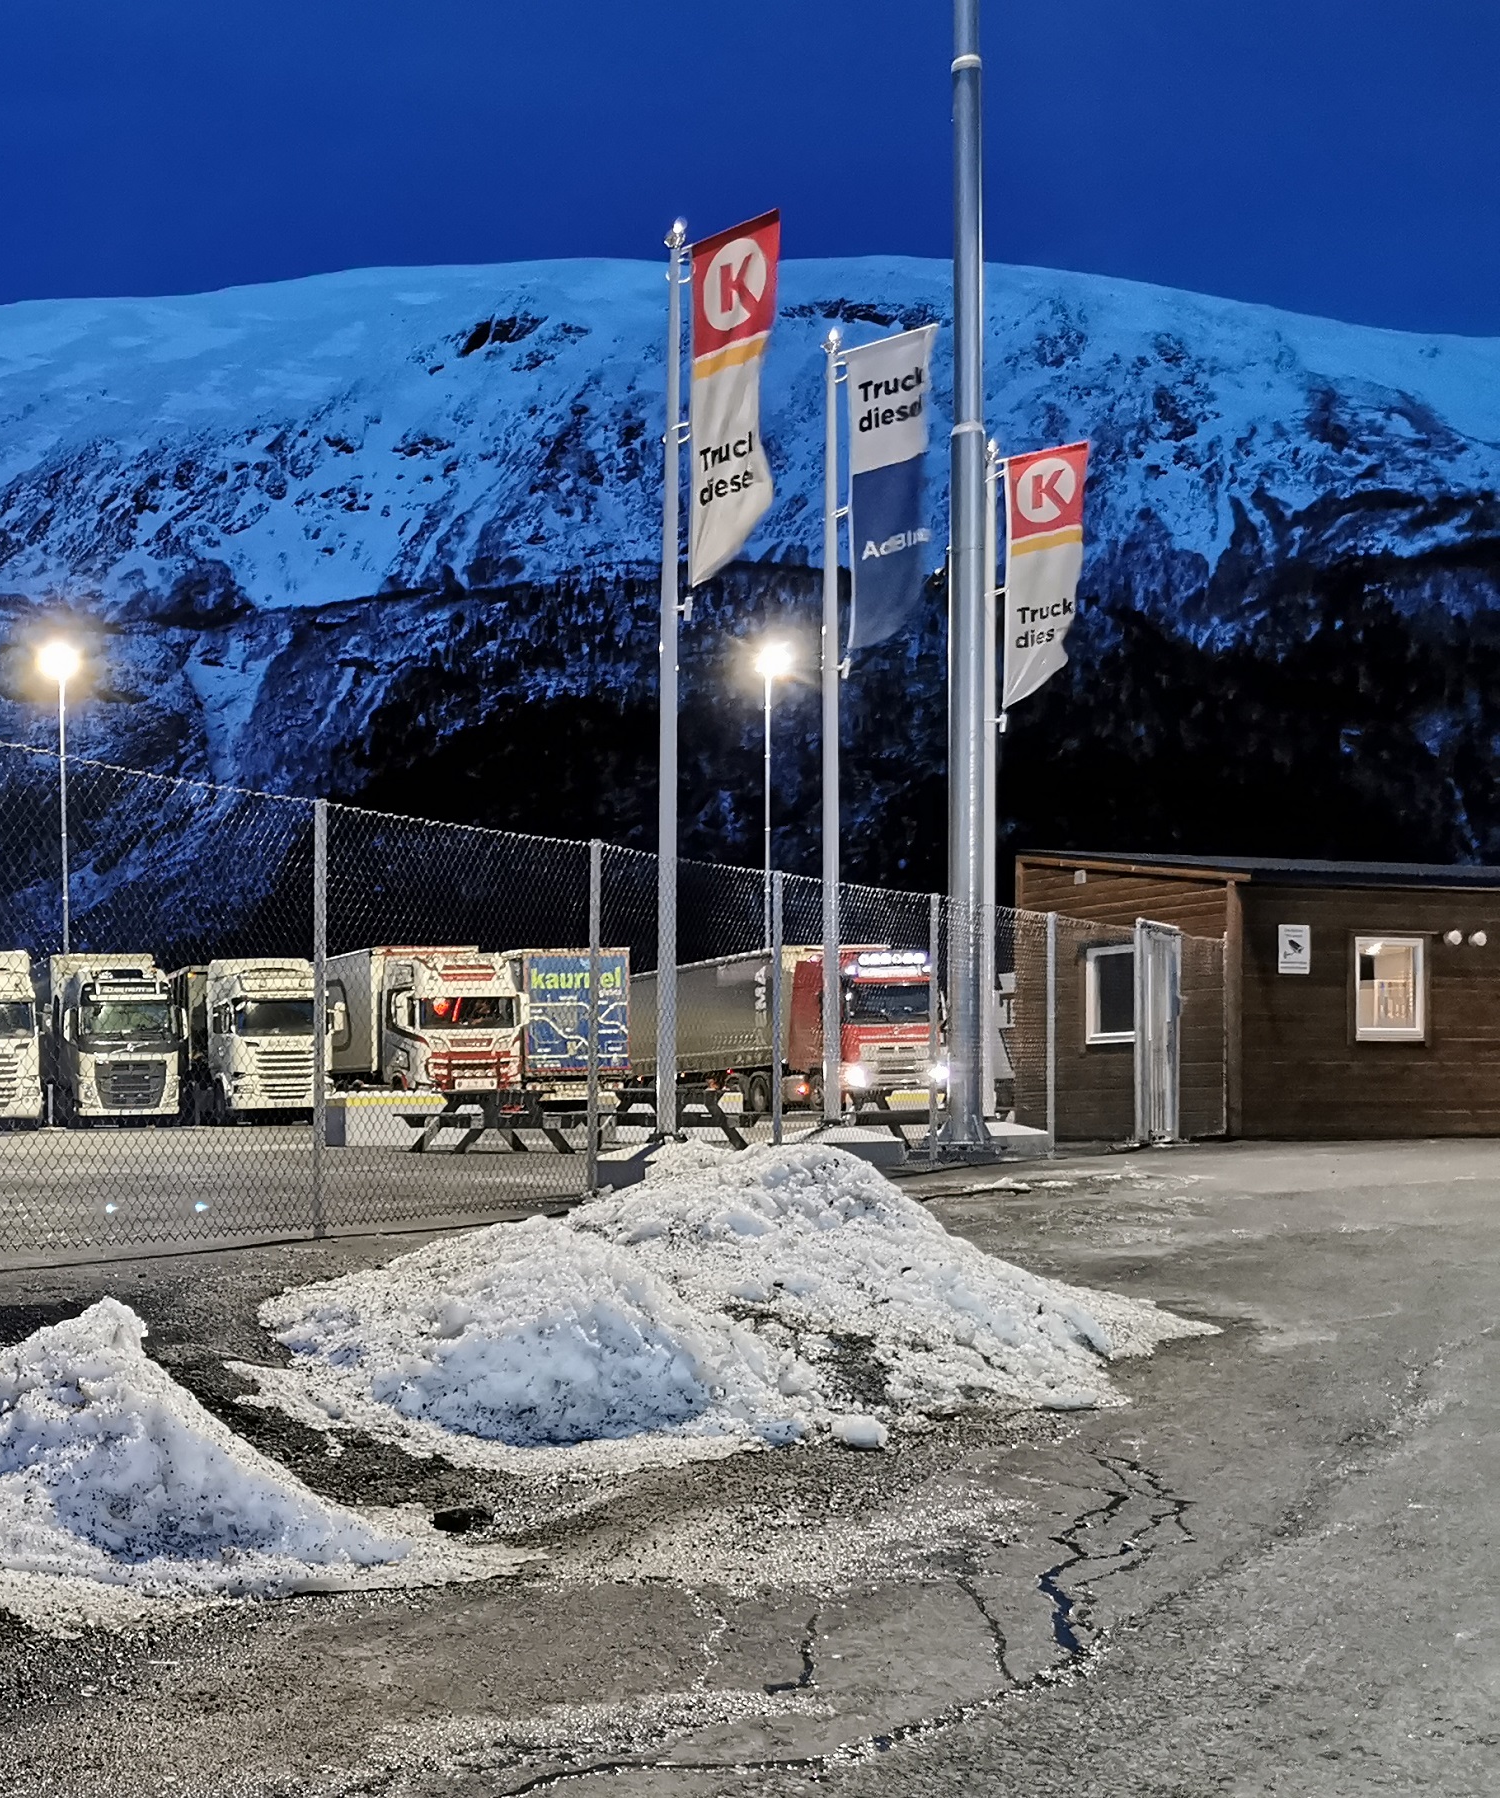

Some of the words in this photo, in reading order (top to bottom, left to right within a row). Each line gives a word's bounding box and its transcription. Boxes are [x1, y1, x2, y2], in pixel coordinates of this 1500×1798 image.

[717, 250, 761, 318] K
[1030, 466, 1072, 513] K
[1016, 597, 1075, 625] Truck
[1015, 628, 1056, 649] dies
